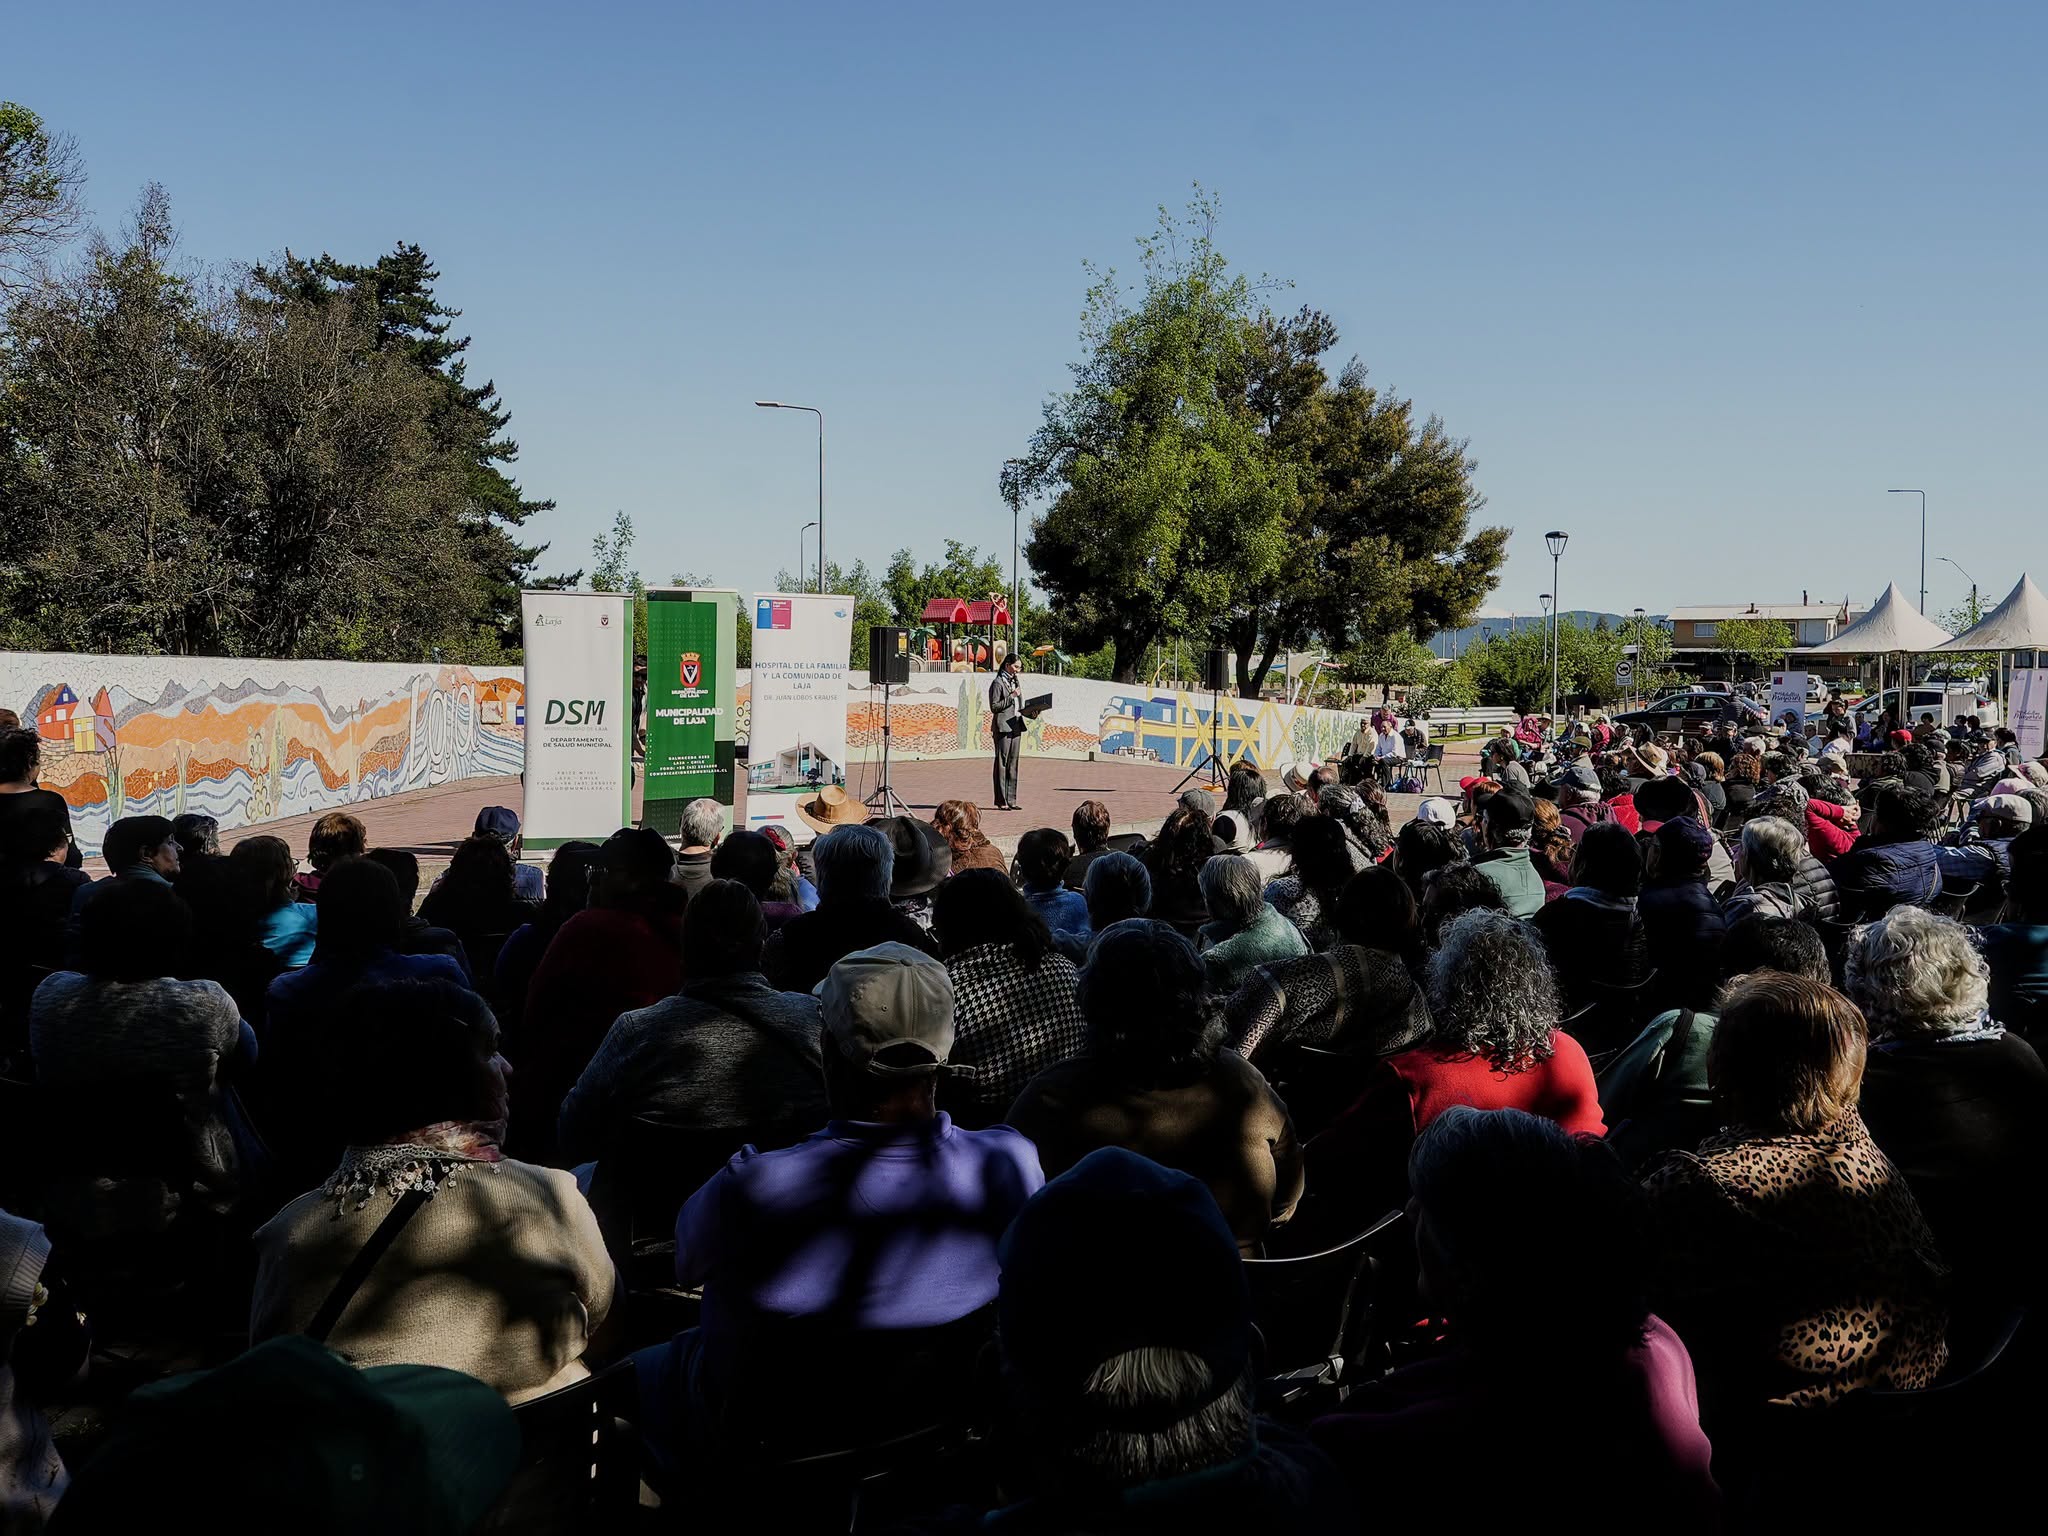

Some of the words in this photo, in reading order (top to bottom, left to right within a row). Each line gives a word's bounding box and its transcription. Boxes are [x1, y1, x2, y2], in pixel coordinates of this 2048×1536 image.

[545, 618, 562, 626] Laja
[544, 700, 606, 725] DSM
[656, 708, 723, 717] MUNICIPALIDAD
[409, 673, 480, 788] Laja
